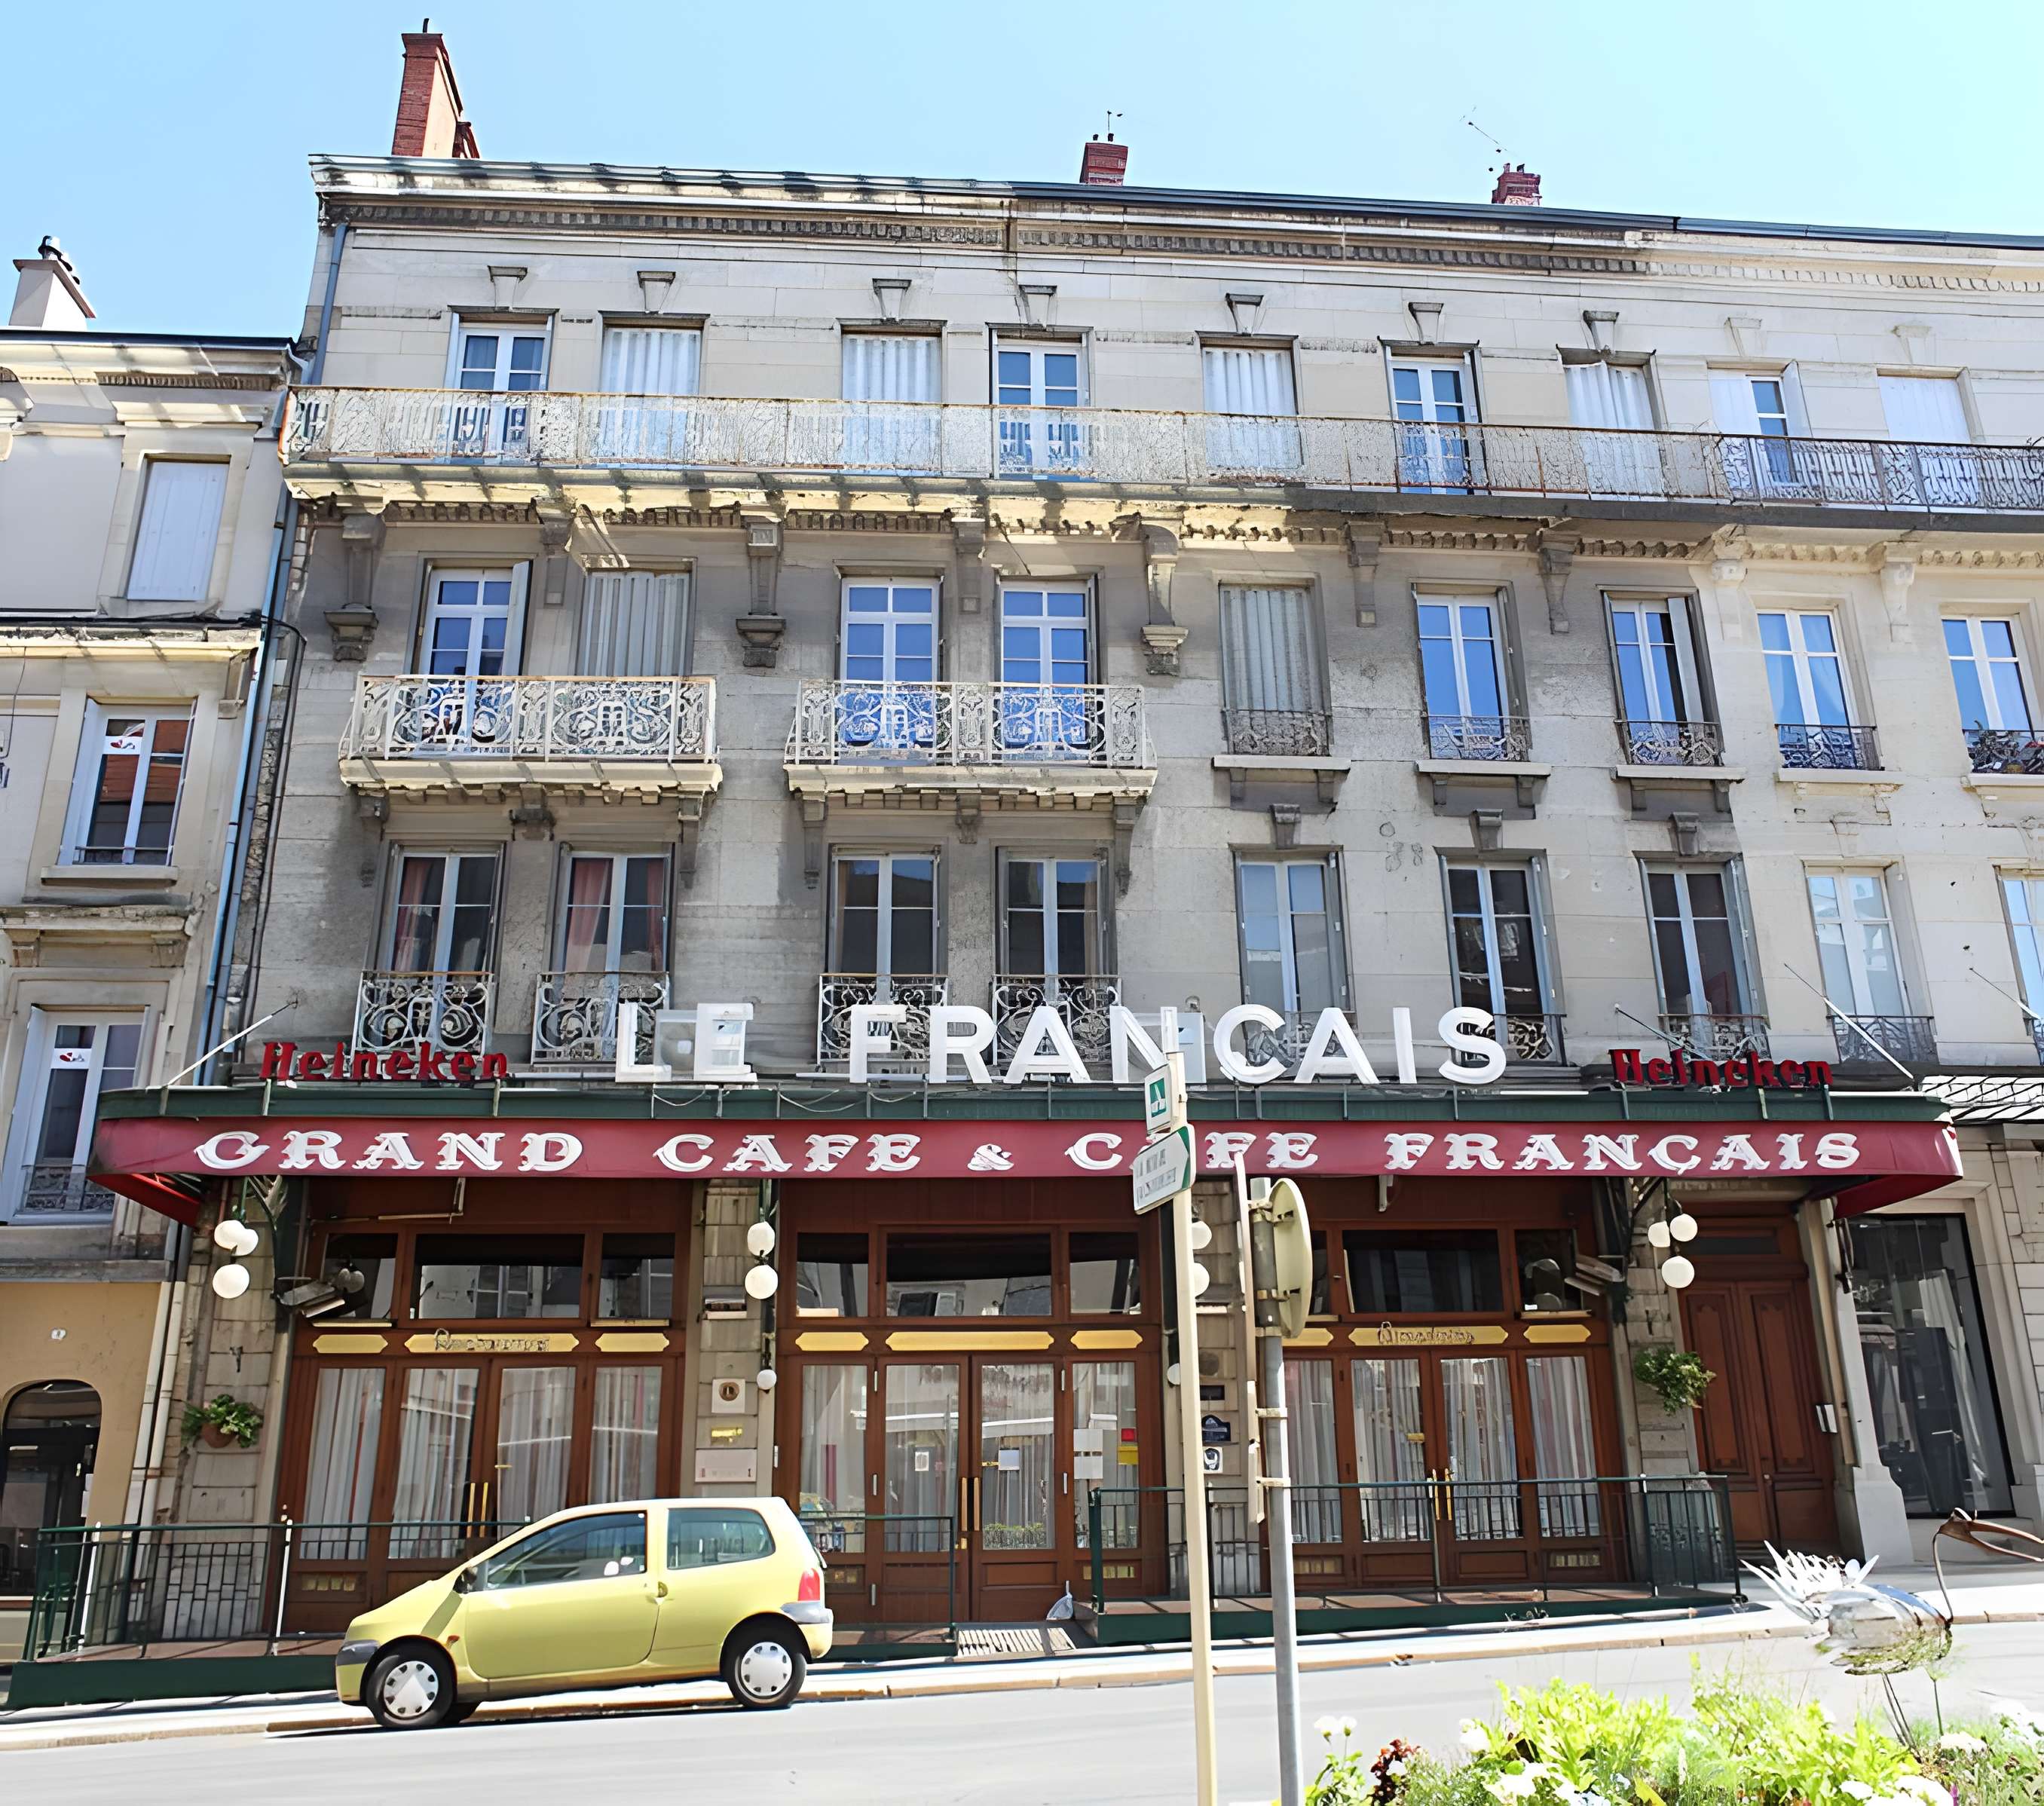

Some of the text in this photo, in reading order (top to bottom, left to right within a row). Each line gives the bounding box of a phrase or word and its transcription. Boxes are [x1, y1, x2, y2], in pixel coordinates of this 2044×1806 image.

[259, 1041, 507, 1082] Heineken
[615, 1002, 1507, 1085] LE FRANCAIS
[1608, 1048, 1834, 1087] Heineken
[194, 1131, 583, 1171] GRAND
[653, 1133, 921, 1171] CAFE
[967, 1143, 1014, 1171] &
[1064, 1132, 1318, 1170] CFE
[1385, 1133, 1860, 1175] FRANÇAIS
